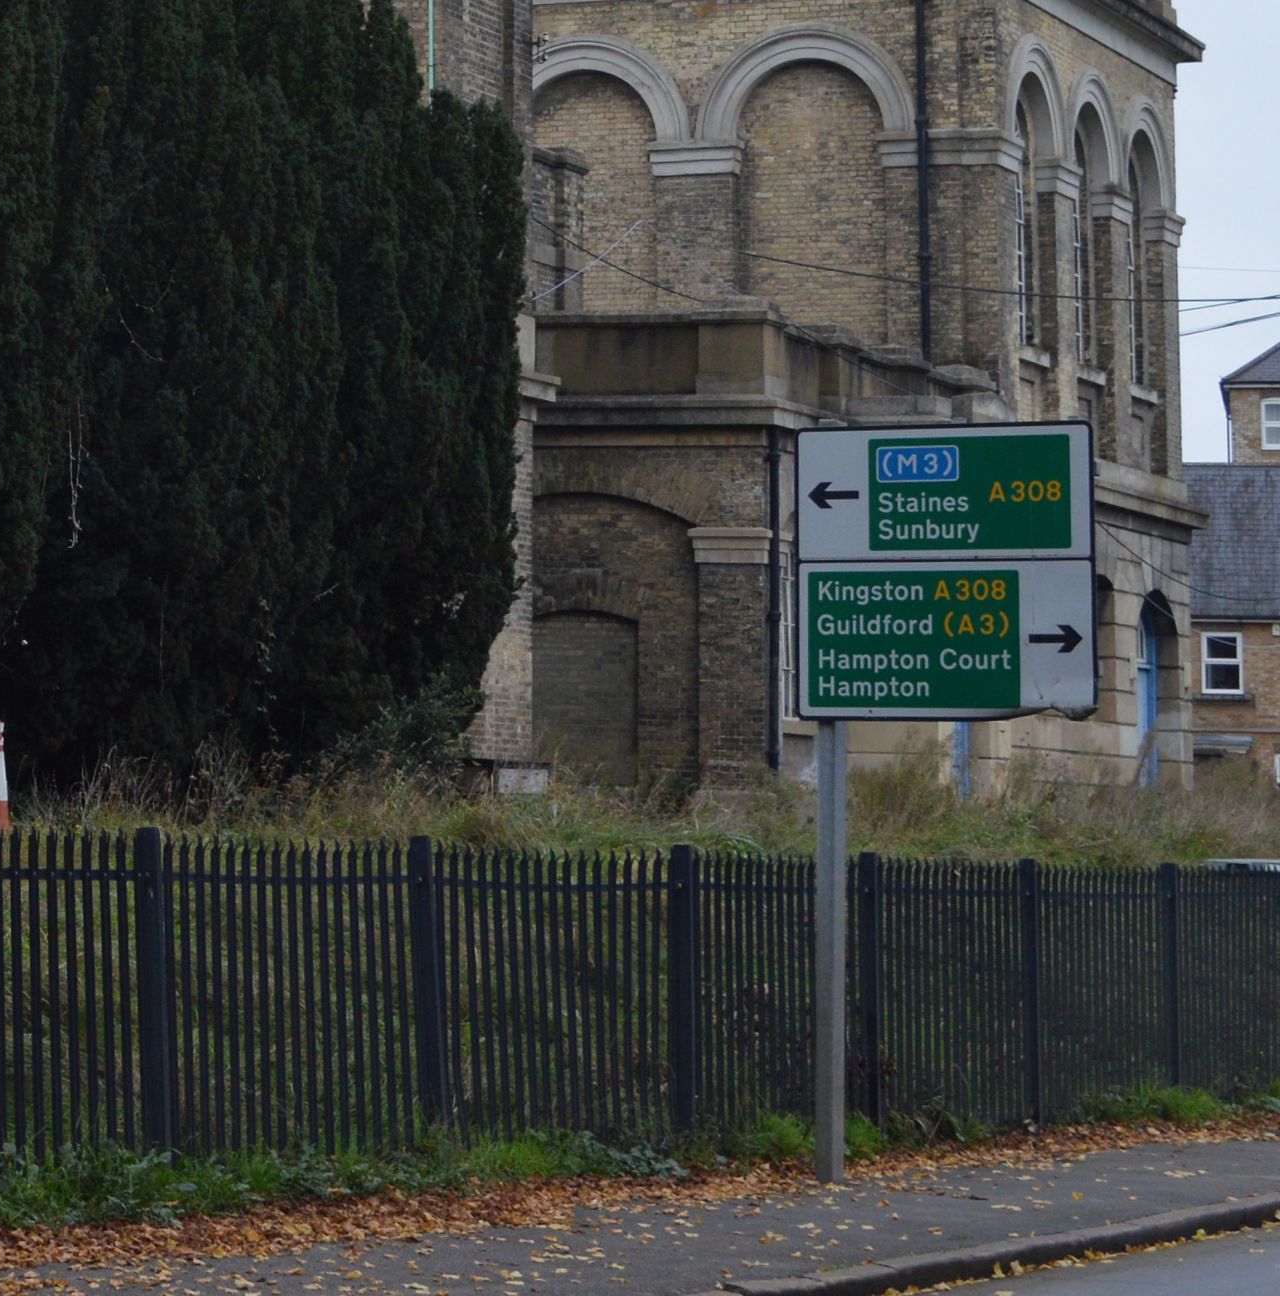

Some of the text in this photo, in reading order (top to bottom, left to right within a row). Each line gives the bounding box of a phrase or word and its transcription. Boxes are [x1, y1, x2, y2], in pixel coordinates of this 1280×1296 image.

[882, 450, 953, 477] (M3)
[878, 492, 969, 513] Staines
[989, 480, 1062, 502] A308
[878, 519, 980, 543] Sunbury
[818, 579, 1007, 605] Kingston A308
[817, 611, 1009, 637] Guildford (A3)
[818, 648, 1011, 673] Hampton Court
[818, 677, 930, 701] Hampton
